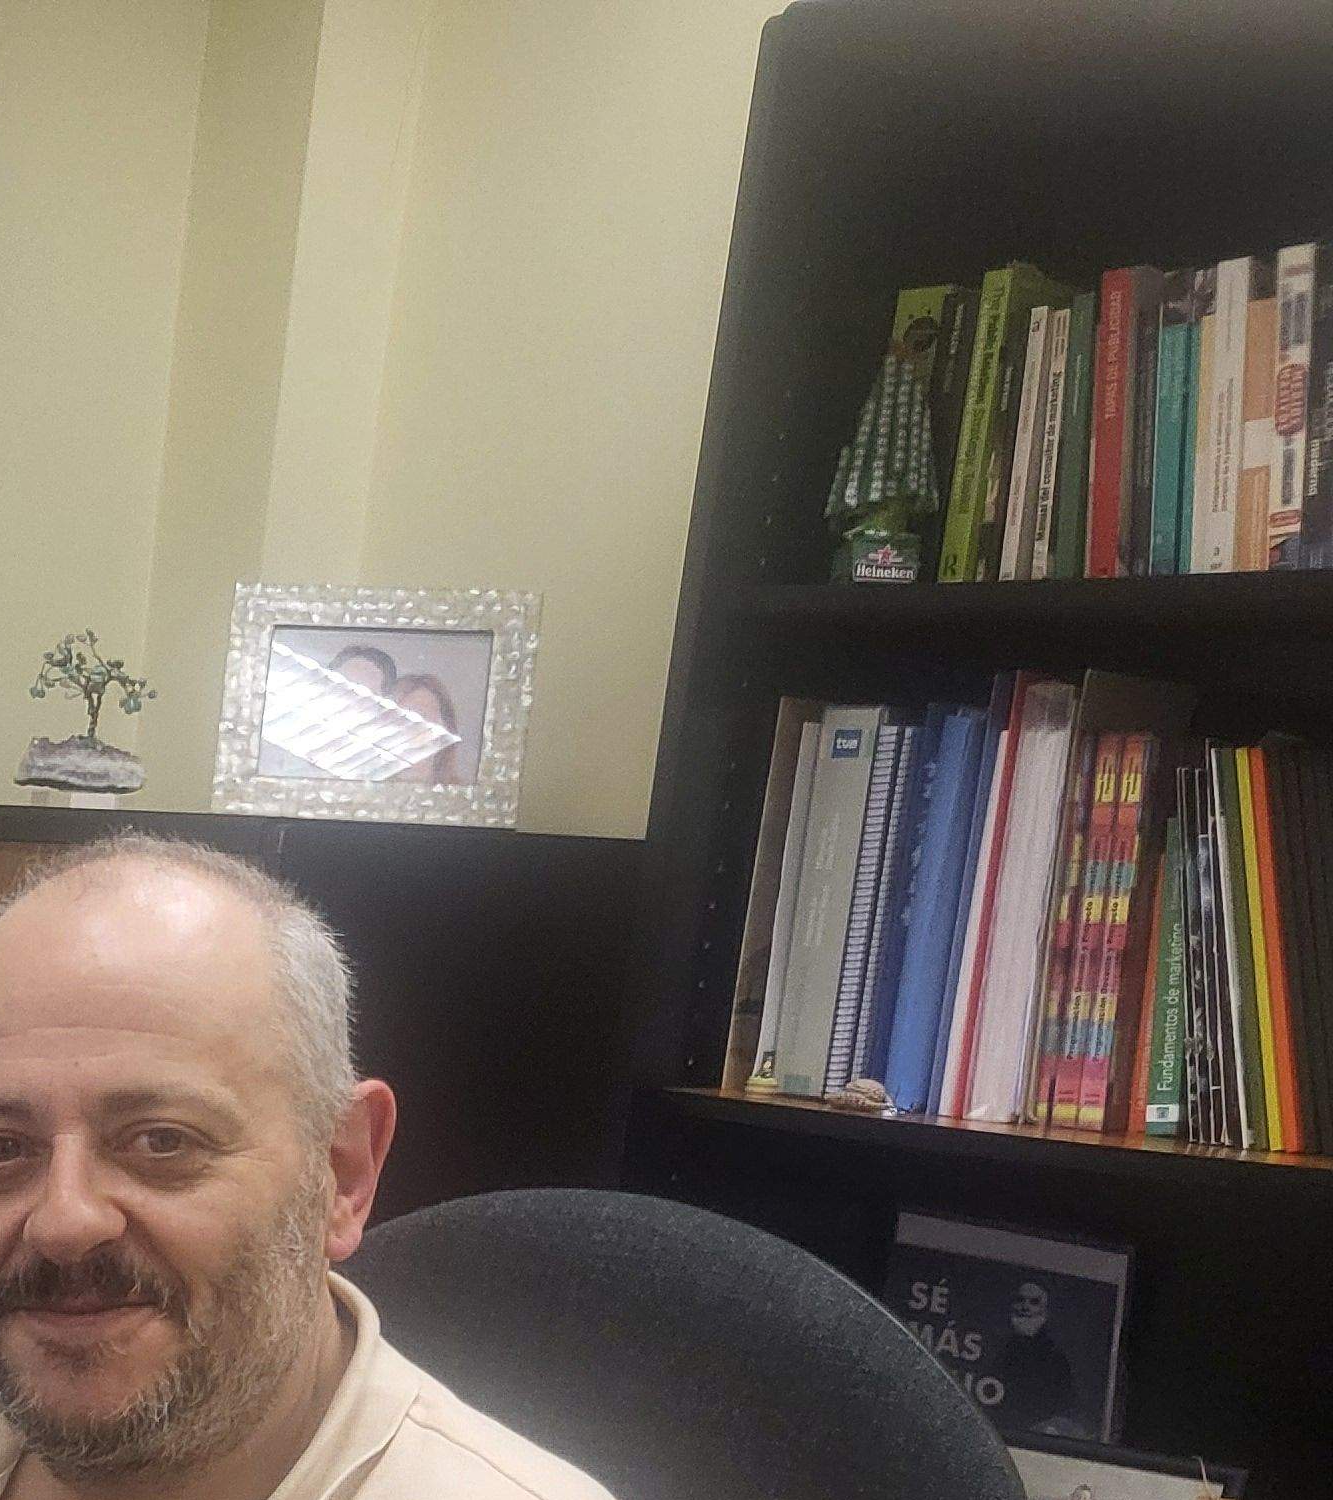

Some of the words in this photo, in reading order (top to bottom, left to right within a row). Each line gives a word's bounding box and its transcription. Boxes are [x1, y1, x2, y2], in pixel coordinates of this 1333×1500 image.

[855, 563, 915, 580] Heineken
[1163, 989, 1180, 1005] de
[1156, 1008, 1178, 1091] Fundamentos
[908, 1278, 949, 1313] SÉ
